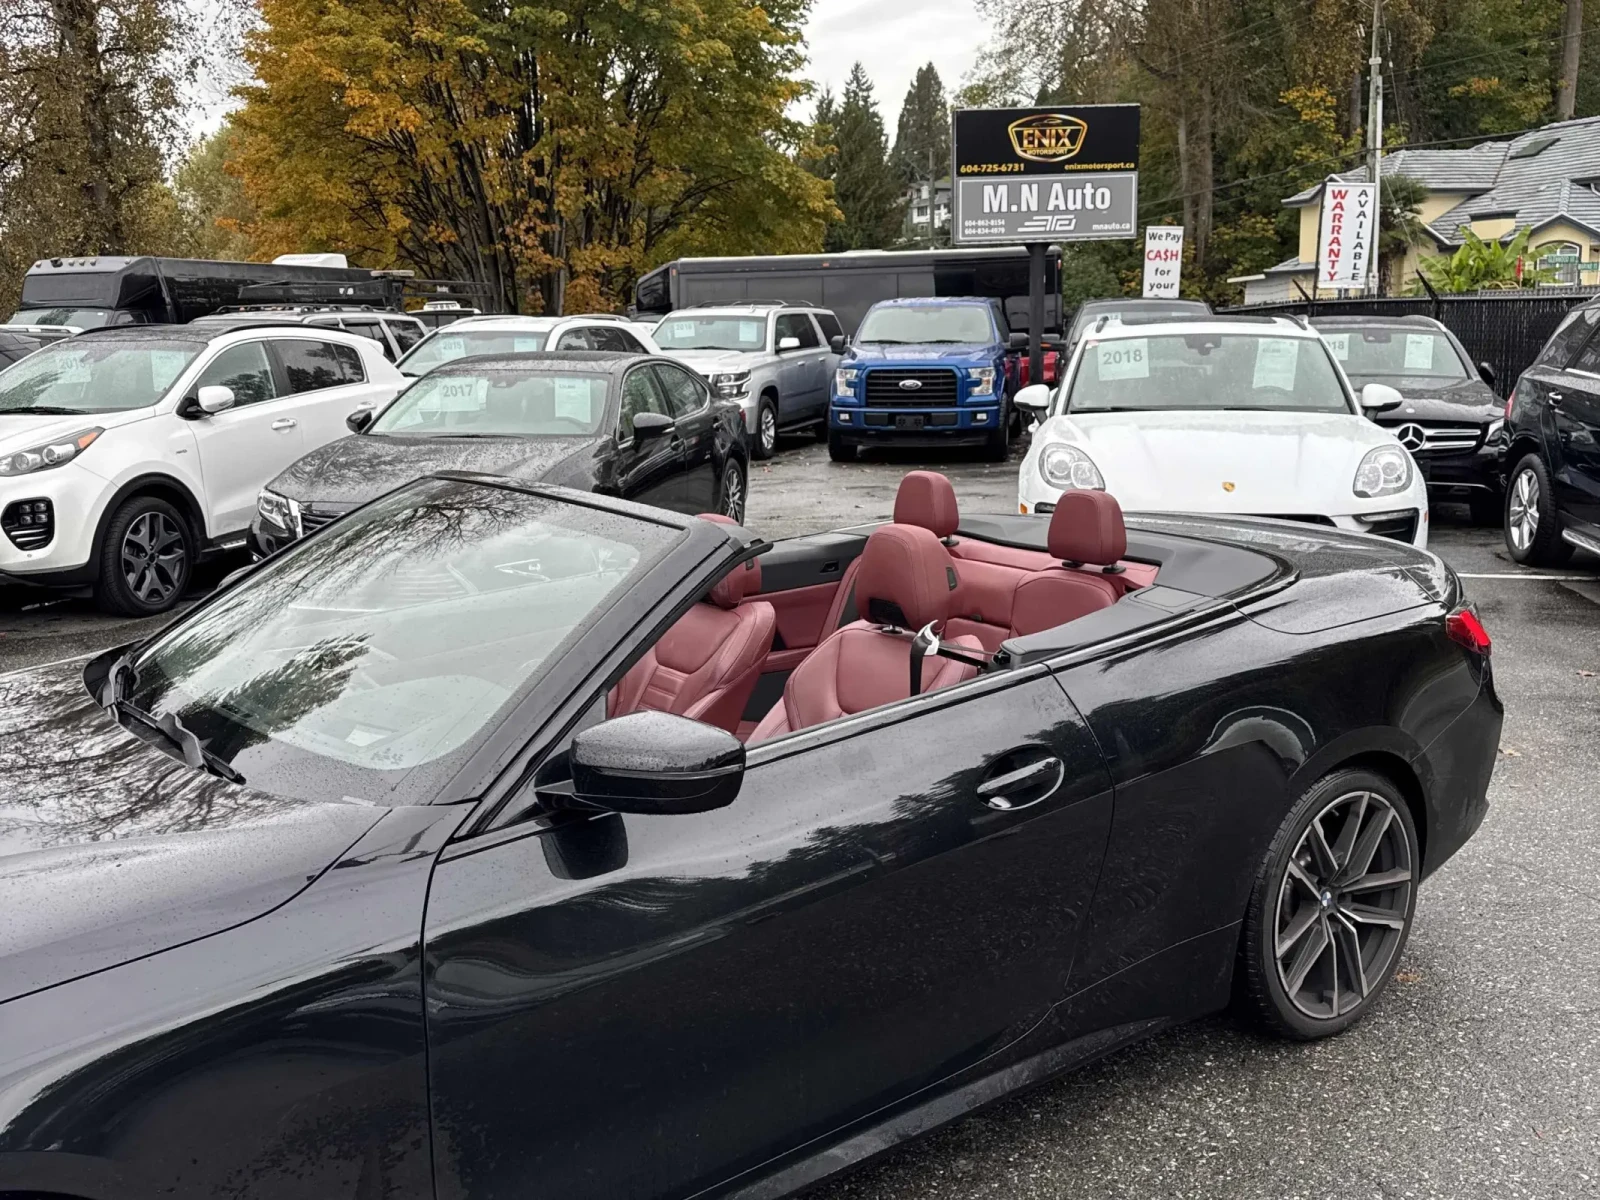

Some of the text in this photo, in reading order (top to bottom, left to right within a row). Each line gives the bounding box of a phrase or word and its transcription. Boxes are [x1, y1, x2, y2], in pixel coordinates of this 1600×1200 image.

[1023, 129, 1071, 148] ENIX
[960, 163, 1025, 173] 604-725-6731
[1064, 162, 1135, 171] enixmotorsport.ca
[983, 182, 1111, 213] M.N Auto
[1092, 222, 1131, 230] mnauto.ca
[1148, 232, 1181, 243] We Pay
[1327, 189, 1349, 281] WARRANTY
[1351, 189, 1369, 281] AVAILABLE
[1146, 249, 1179, 262] CA$H
[1154, 267, 1171, 276] for
[1148, 282, 1175, 291] your
[1103, 349, 1143, 365] 2018
[442, 384, 473, 397] 2017
